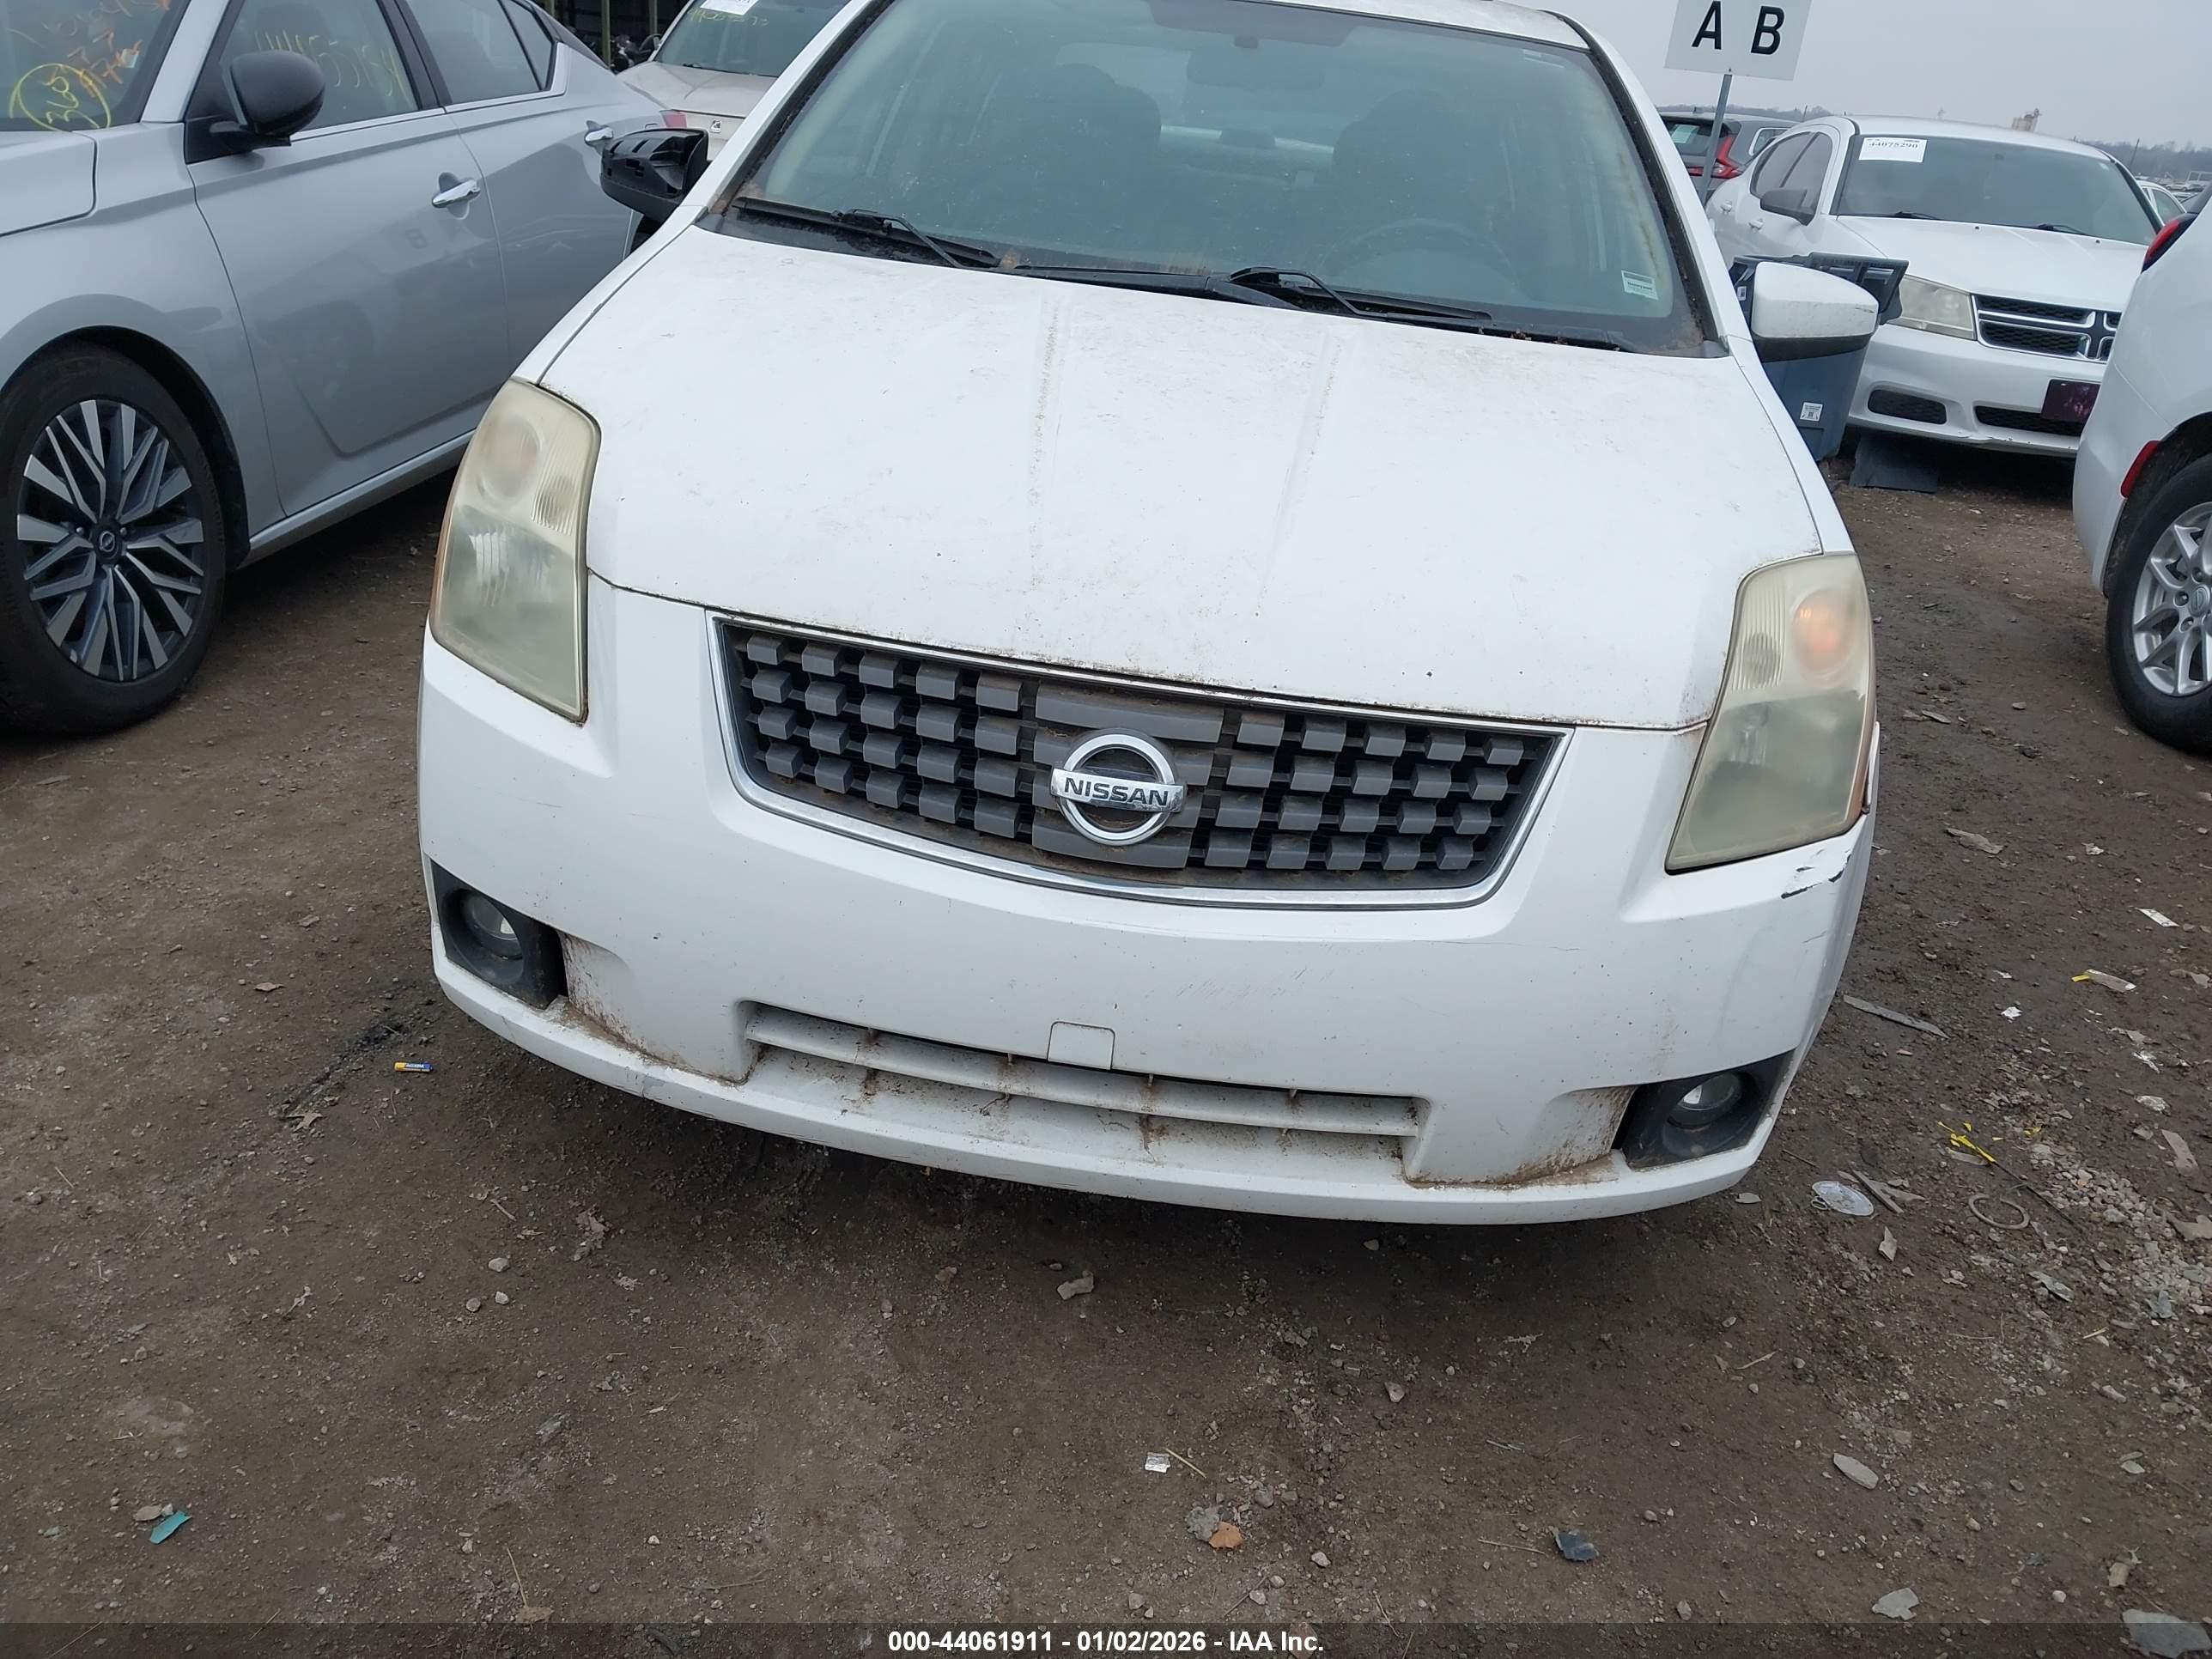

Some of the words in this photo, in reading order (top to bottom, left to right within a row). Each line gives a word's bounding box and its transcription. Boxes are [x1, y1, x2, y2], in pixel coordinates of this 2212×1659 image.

[1692, 1, 1722, 50] A
[1751, 6, 1784, 55] B
[1064, 777, 1170, 806] NISSAN
